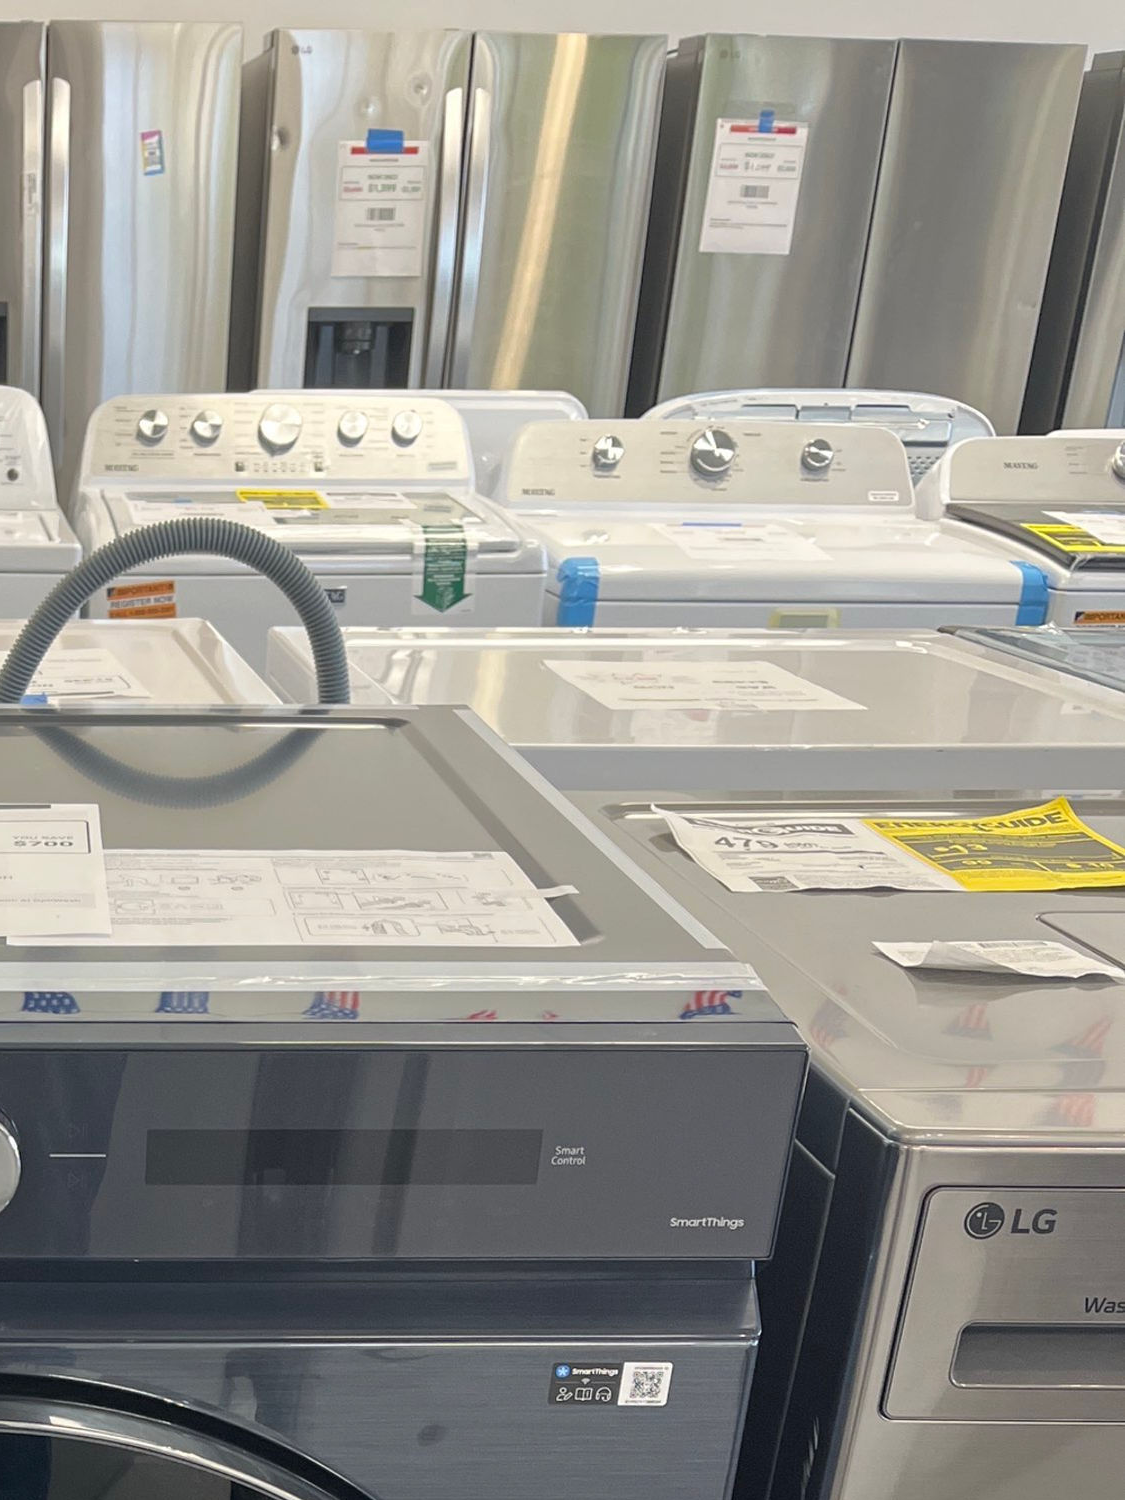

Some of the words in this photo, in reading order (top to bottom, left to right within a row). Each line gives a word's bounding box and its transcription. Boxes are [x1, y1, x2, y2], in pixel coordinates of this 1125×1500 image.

[1003, 462, 1038, 470] MAYTAG
[555, 1146, 585, 1156] Smart
[550, 1156, 586, 1166] Control
[669, 1216, 745, 1230] SmartThings
[1010, 1208, 1057, 1235] LG
[571, 1367, 618, 1377] SmartThings
